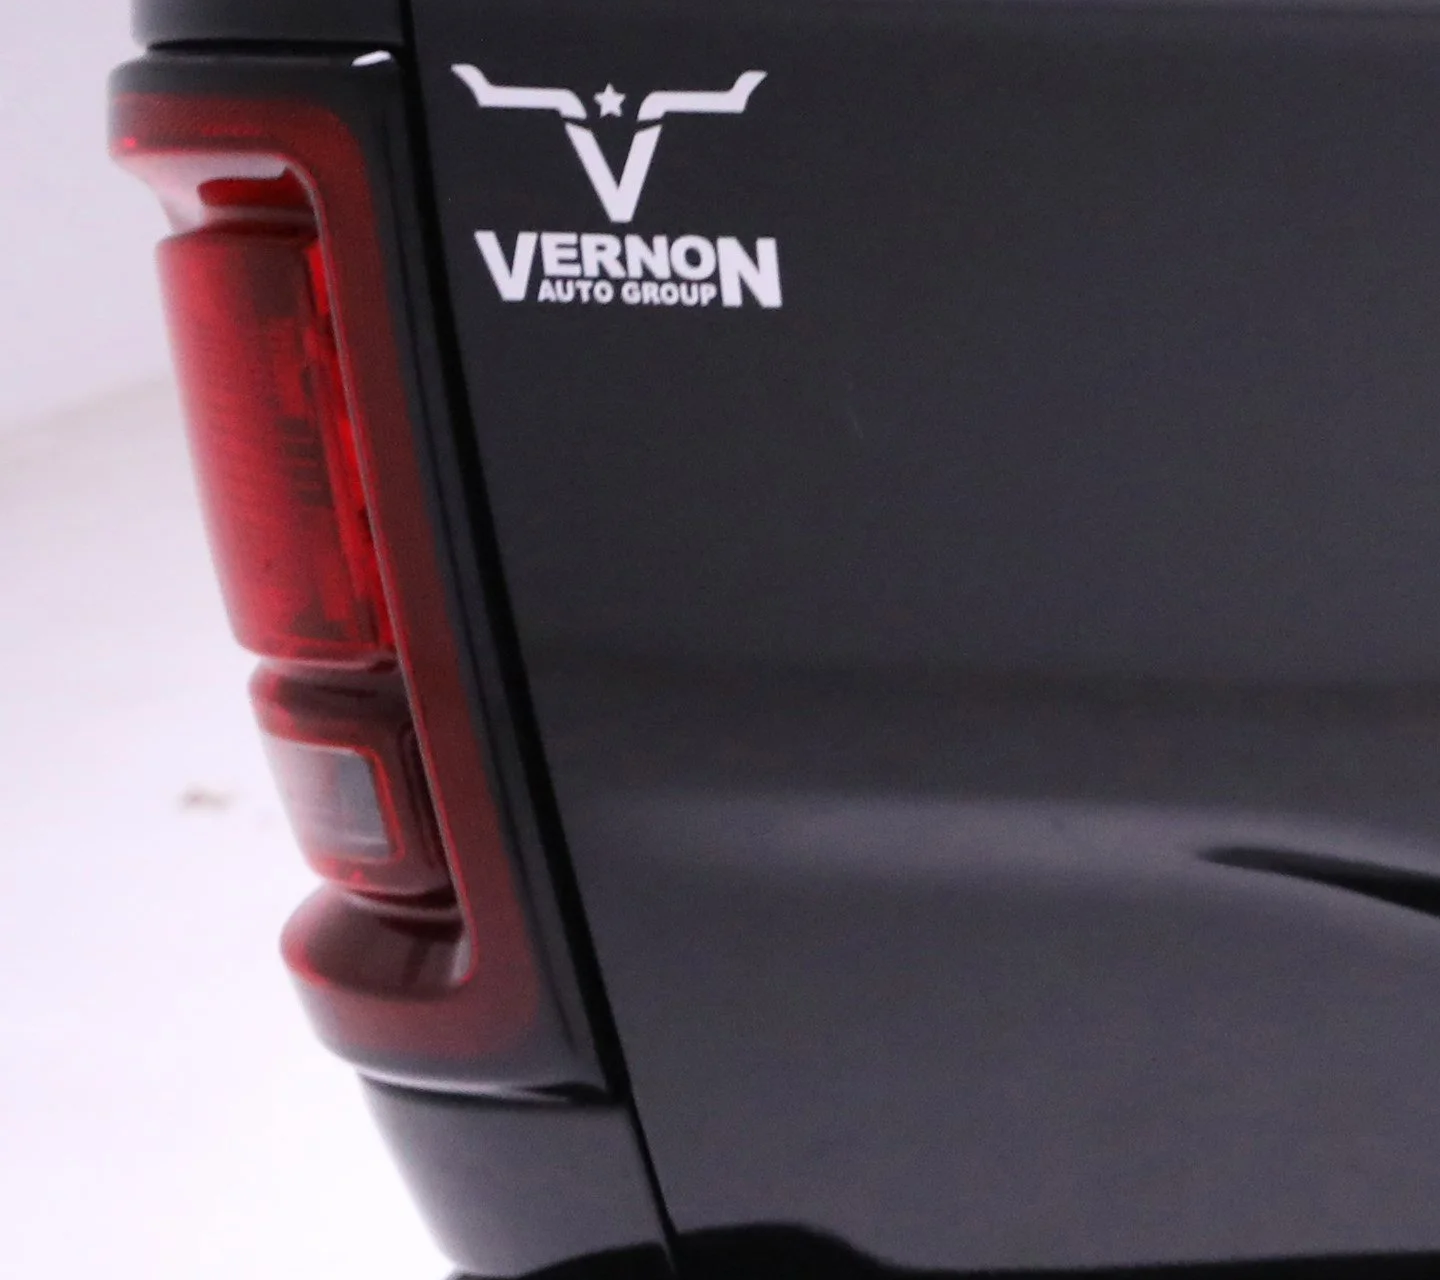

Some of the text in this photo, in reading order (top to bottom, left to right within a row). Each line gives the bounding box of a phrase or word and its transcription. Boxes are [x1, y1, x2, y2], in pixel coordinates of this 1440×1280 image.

[474, 230, 783, 308] VERNON
[537, 280, 717, 306] AUTO GROUP
